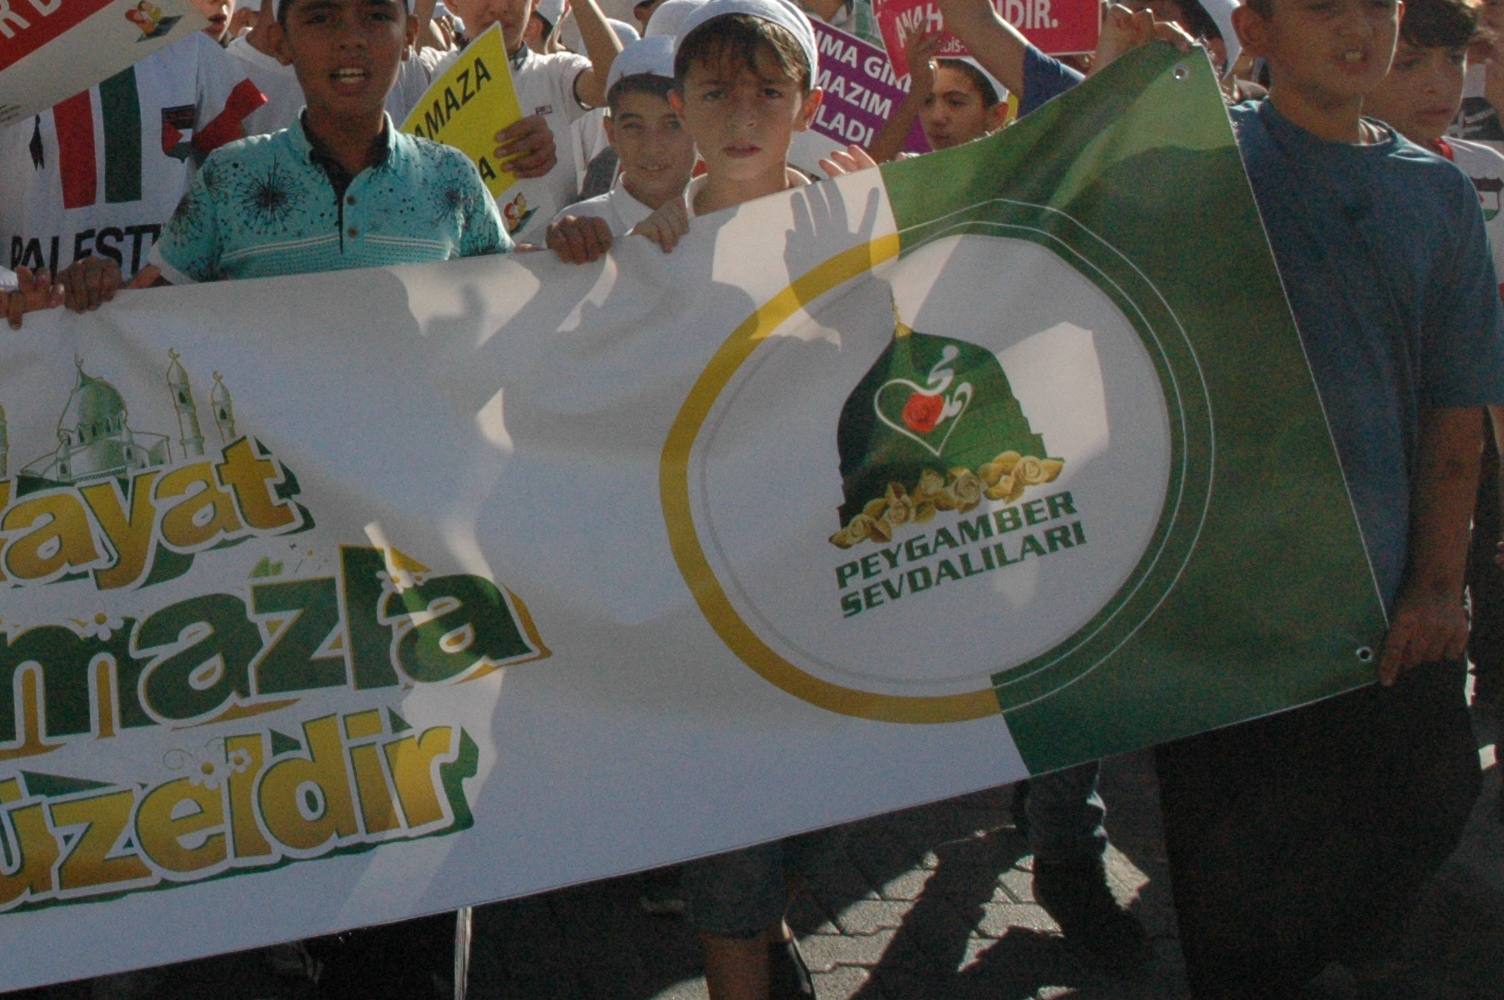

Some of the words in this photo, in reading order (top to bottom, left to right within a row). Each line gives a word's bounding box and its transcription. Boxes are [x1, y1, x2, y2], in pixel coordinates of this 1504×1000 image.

[414, 57, 493, 142] AMAZA
[815, 104, 874, 148] LADI
[816, 66, 892, 120] MAZIM
[835, 491, 1078, 590] PEYGAMBER
[840, 520, 1087, 619] SEVDALILARI
